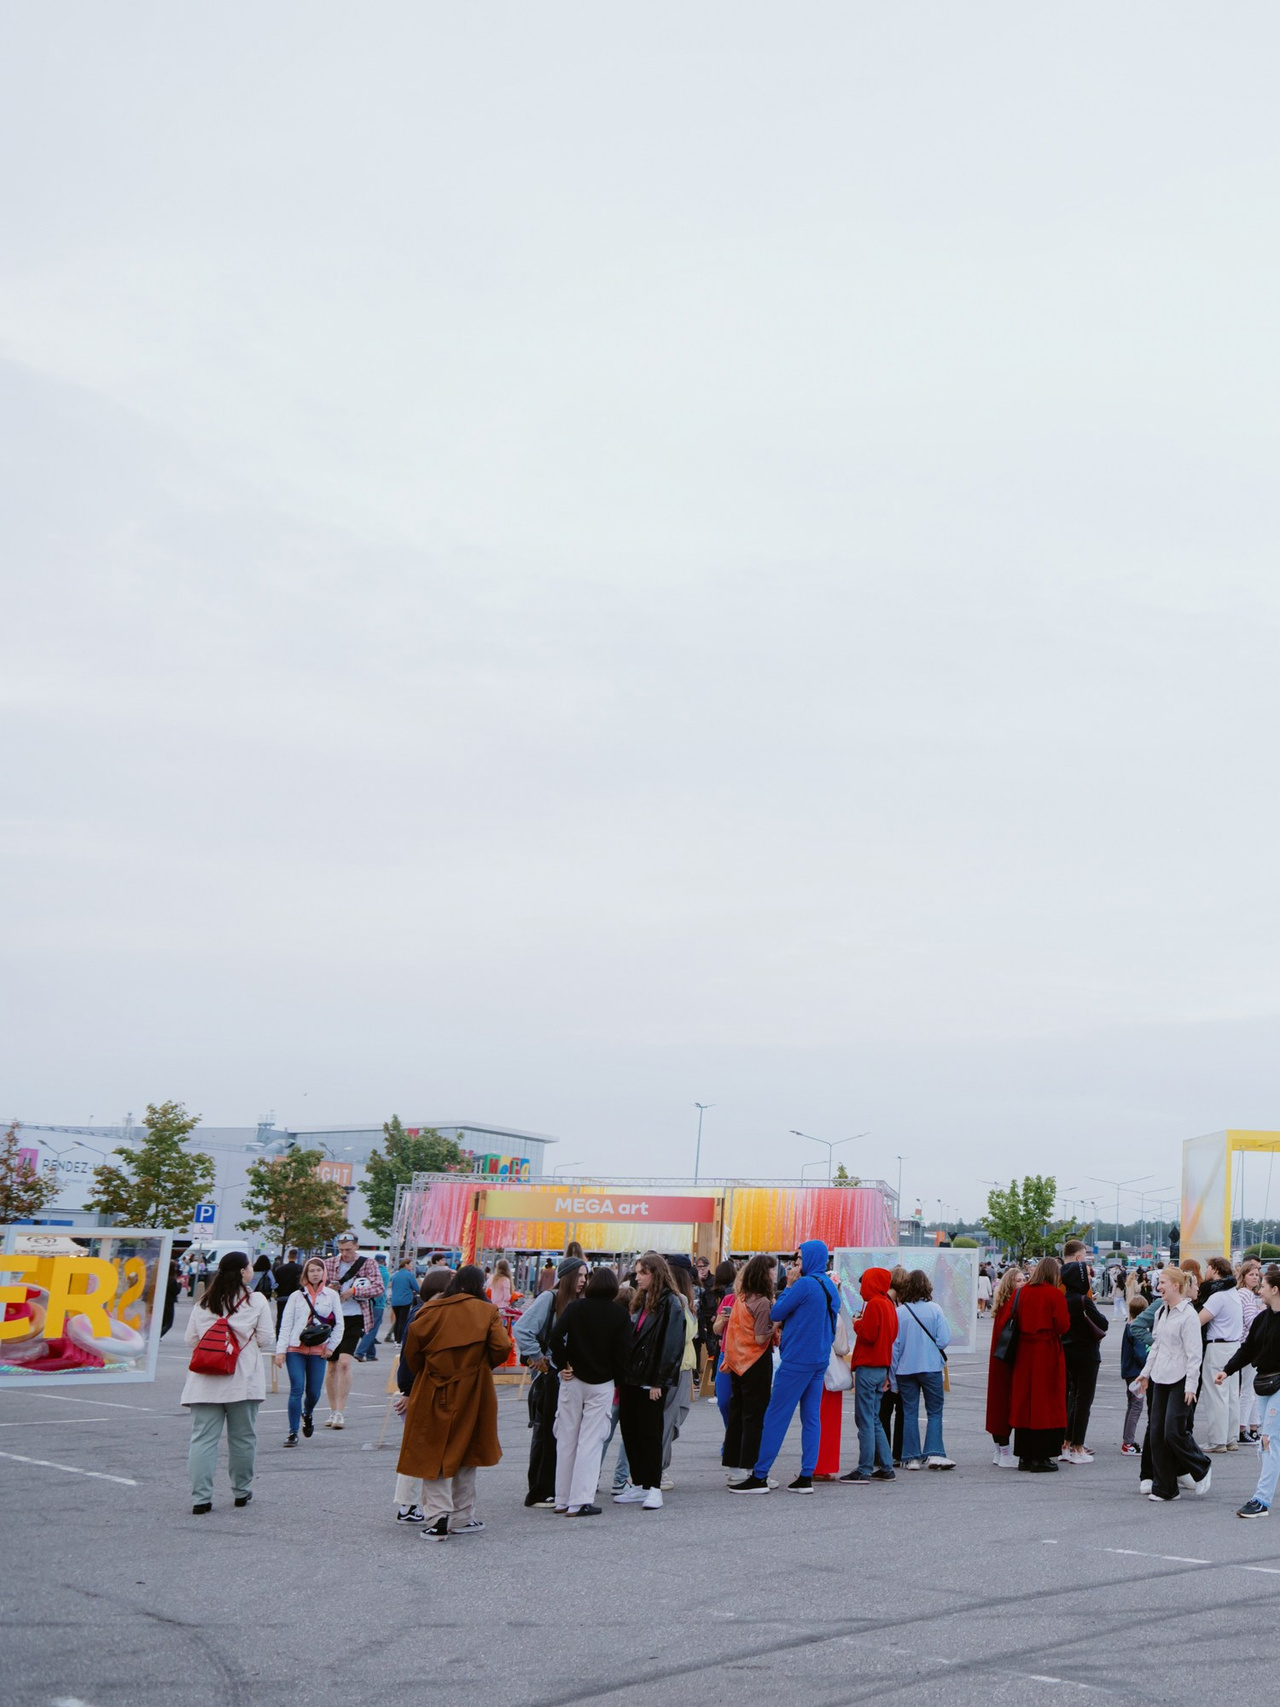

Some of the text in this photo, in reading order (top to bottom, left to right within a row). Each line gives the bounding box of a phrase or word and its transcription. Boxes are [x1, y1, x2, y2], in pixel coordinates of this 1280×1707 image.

[200, 1206, 212, 1221] P
[554, 1198, 649, 1215] MEGA art
